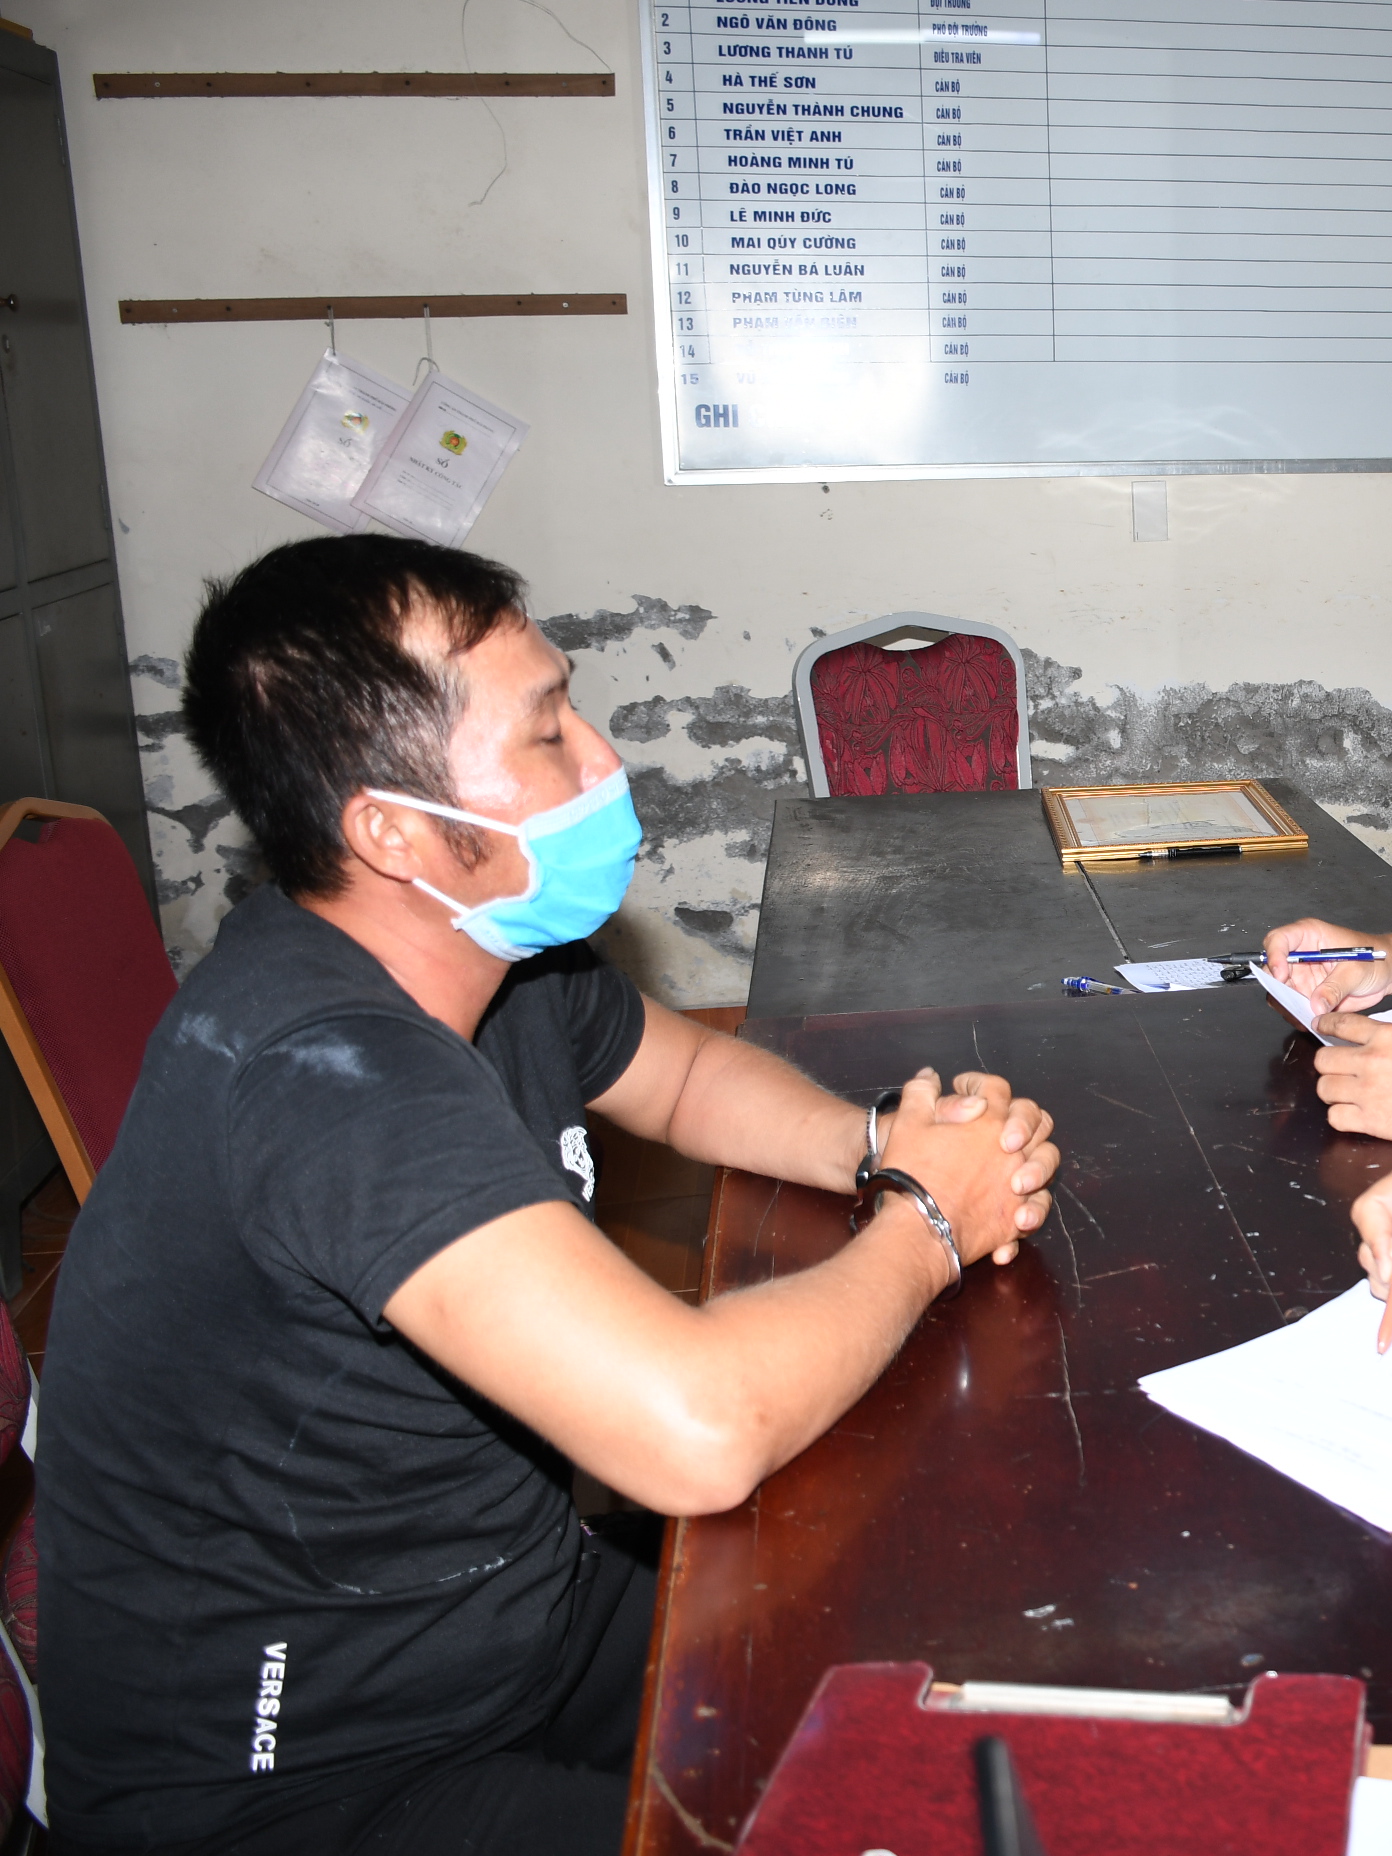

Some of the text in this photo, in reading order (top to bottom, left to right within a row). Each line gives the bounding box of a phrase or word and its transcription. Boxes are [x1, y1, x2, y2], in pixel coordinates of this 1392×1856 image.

[661, 13, 669, 27] 2
[717, 14, 749, 28] NGÔ
[756, 15, 788, 30] VĂN
[663, 42, 853, 60] 3 LƯƠNG THANH TÚ
[951, 52, 964, 63] TRA
[665, 70, 816, 89] 4 HÀ THẾ SƠN
[667, 98, 904, 118] 5 NGUYỄN THÀNH CHUNG
[668, 127, 675, 139] 6
[771, 127, 804, 145] VIỆT
[810, 131, 842, 142] ANH
[669, 153, 854, 170] 7 HOÀNG MINH TÚ
[671, 179, 857, 197] 8 ĐÀO NGỌC LONG
[673, 207, 832, 223] 9 LÊ MINH ĐỨC
[675, 234, 689, 248] 10
[731, 237, 761, 249] MAI
[675, 263, 689, 276] 11
[730, 259, 792, 276] NGUYỄN
[799, 262, 819, 276] BÁ
[677, 292, 692, 304] 12
[678, 318, 693, 331] 13
[695, 404, 738, 428] GHI
[252, 1641, 288, 1773] VERSACE
